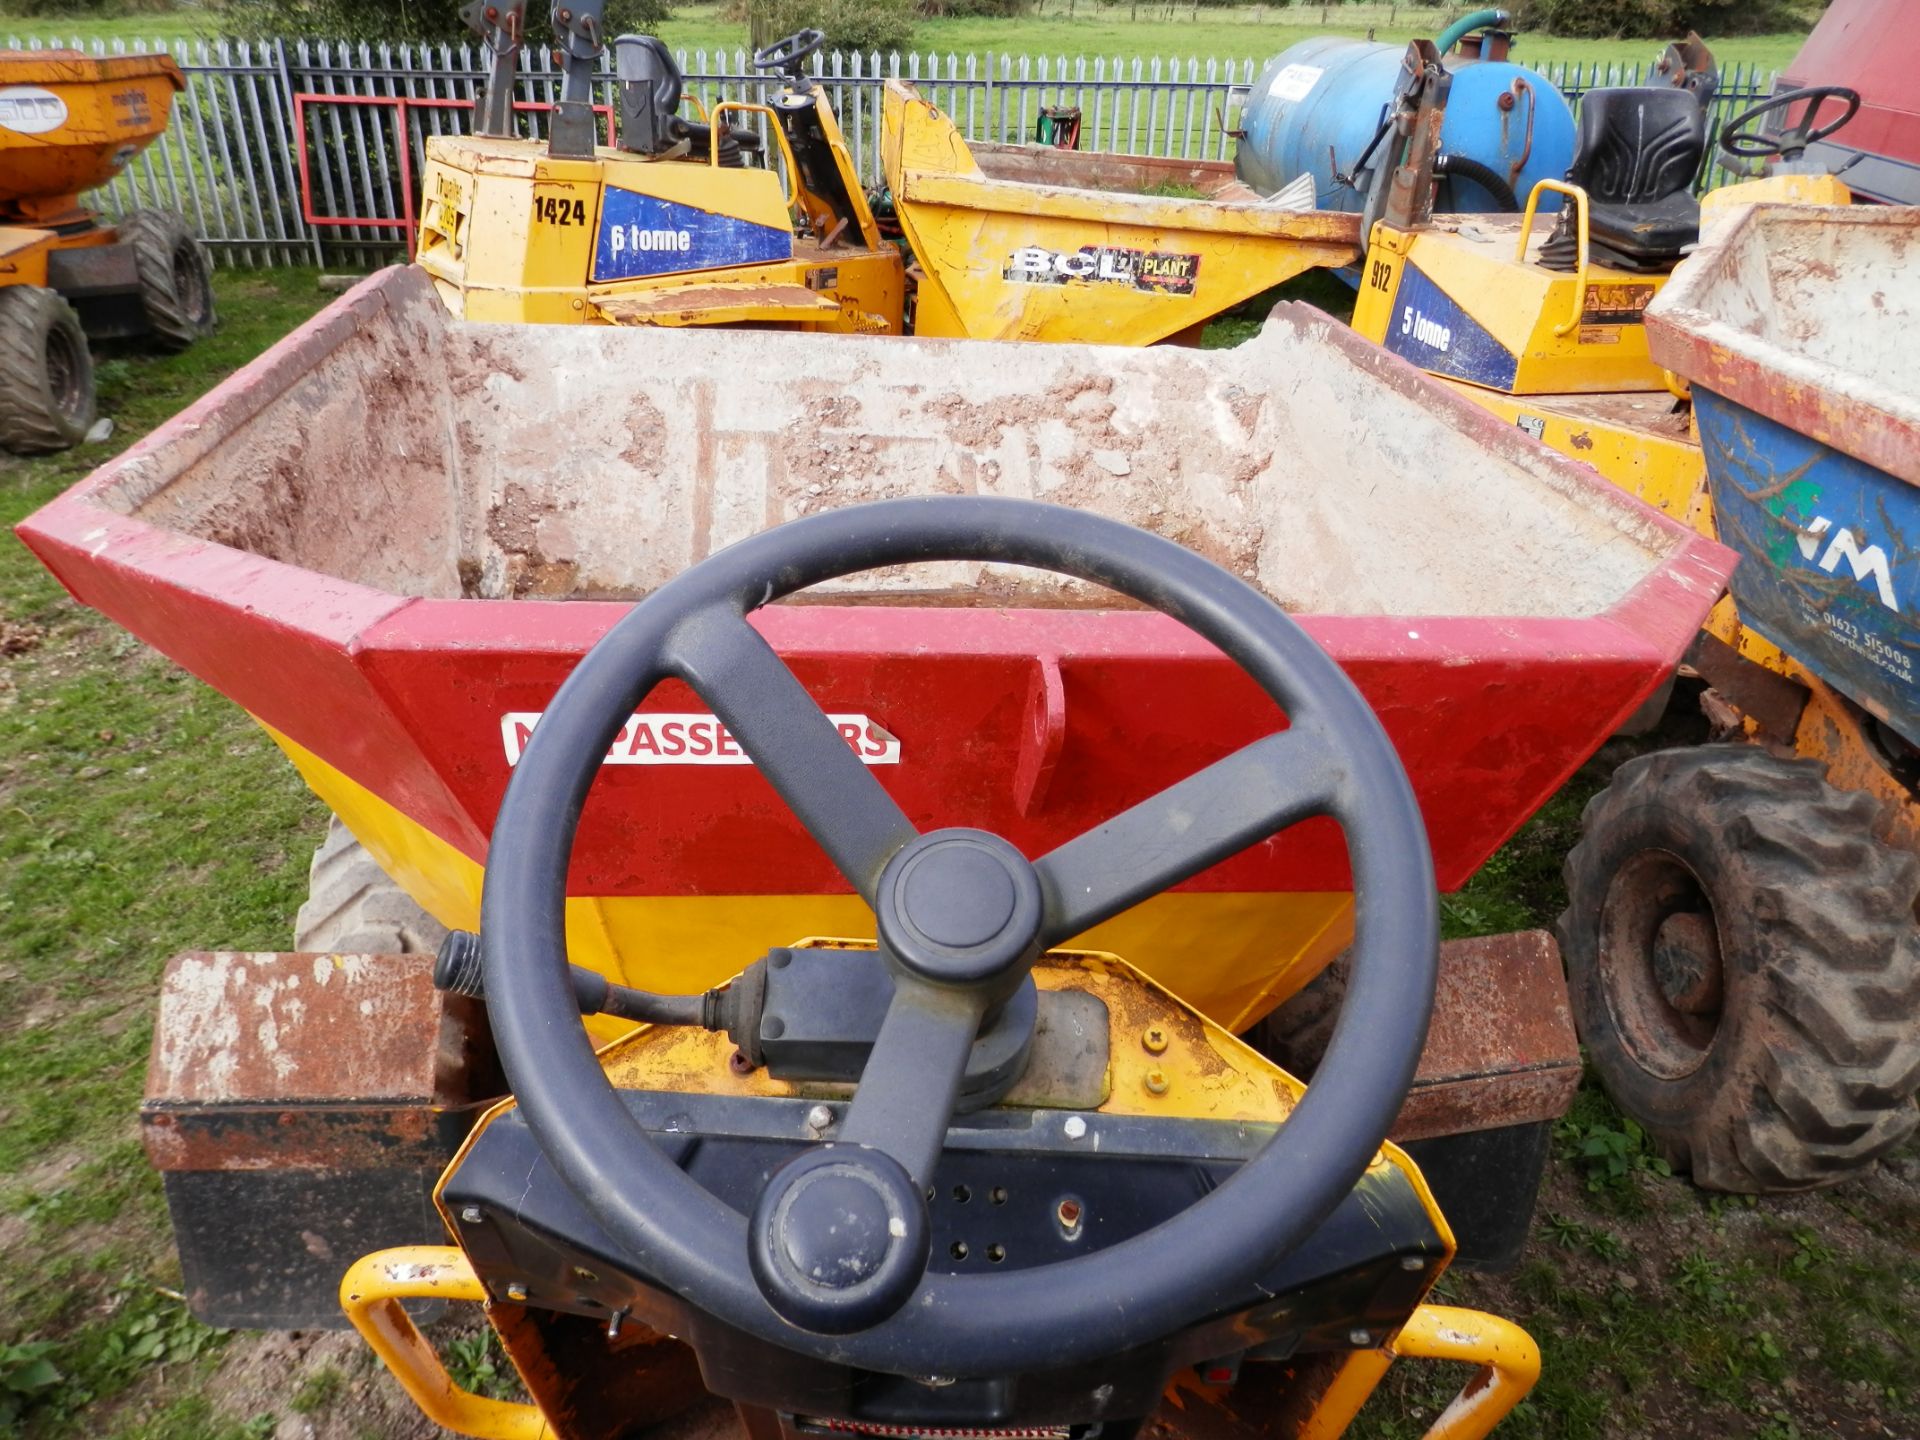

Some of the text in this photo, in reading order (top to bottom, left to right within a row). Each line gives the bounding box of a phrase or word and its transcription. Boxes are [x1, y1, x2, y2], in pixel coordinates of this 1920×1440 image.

[534, 195, 586, 226] 1424
[611, 224, 691, 251] 6 tonne
[1143, 256, 1192, 277] PLANT
[1370, 259, 1392, 293] 912
[1401, 305, 1451, 352] 5 tonne
[1823, 611, 1859, 639] 01623
[1864, 632, 1912, 669] 515008
